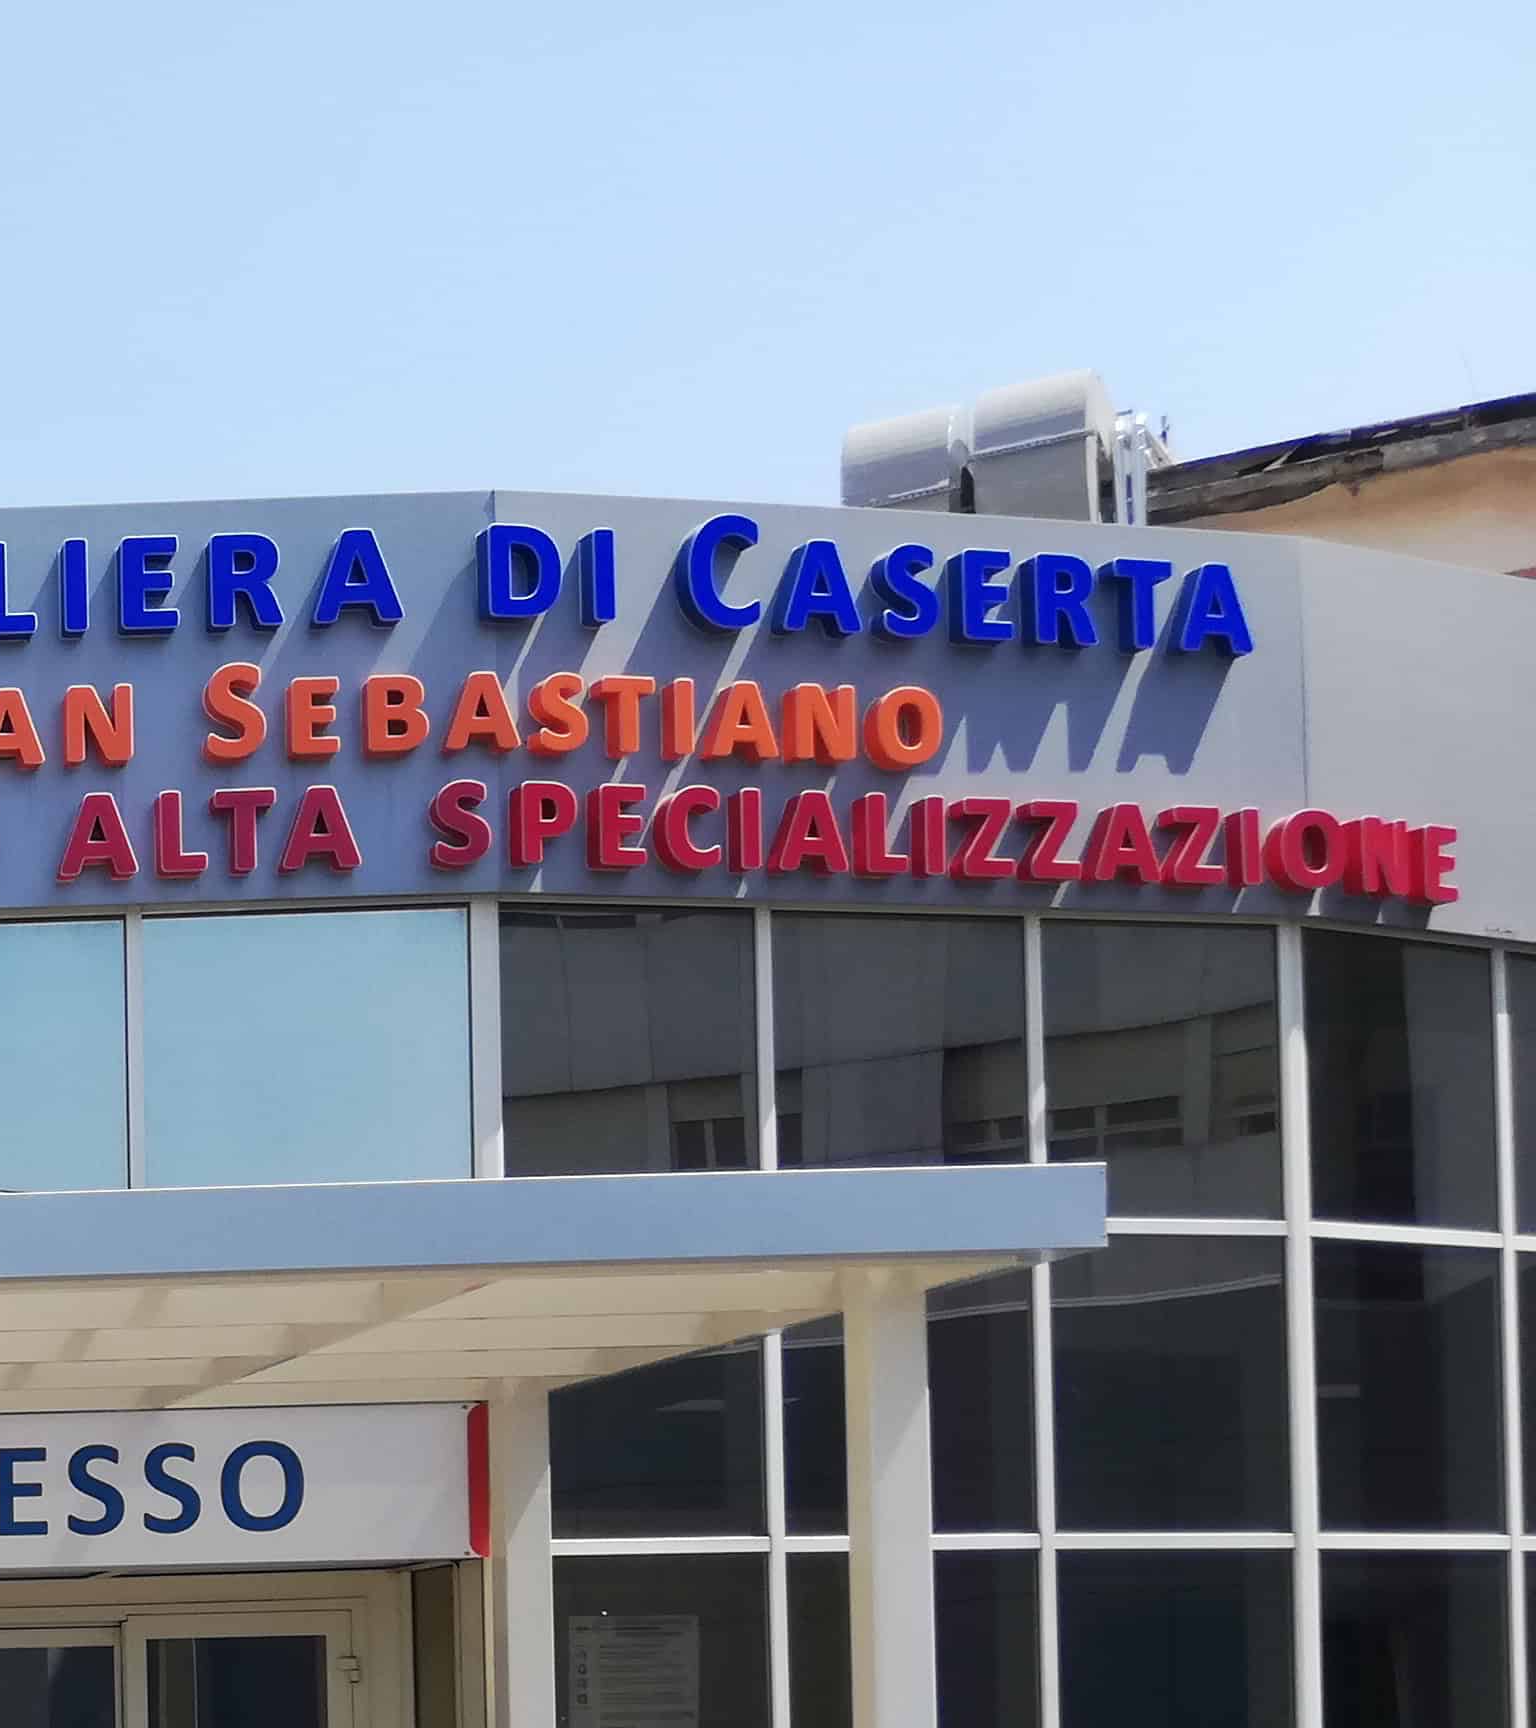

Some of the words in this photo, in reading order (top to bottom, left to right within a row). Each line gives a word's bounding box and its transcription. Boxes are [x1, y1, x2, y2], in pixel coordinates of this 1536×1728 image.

[475, 522, 615, 628] DI
[675, 511, 1255, 658] CASERTA
[201, 662, 943, 772] SEBASTIANO
[54, 784, 363, 882] ALTA
[428, 779, 1460, 906] SPECIALIZZAZIONE
